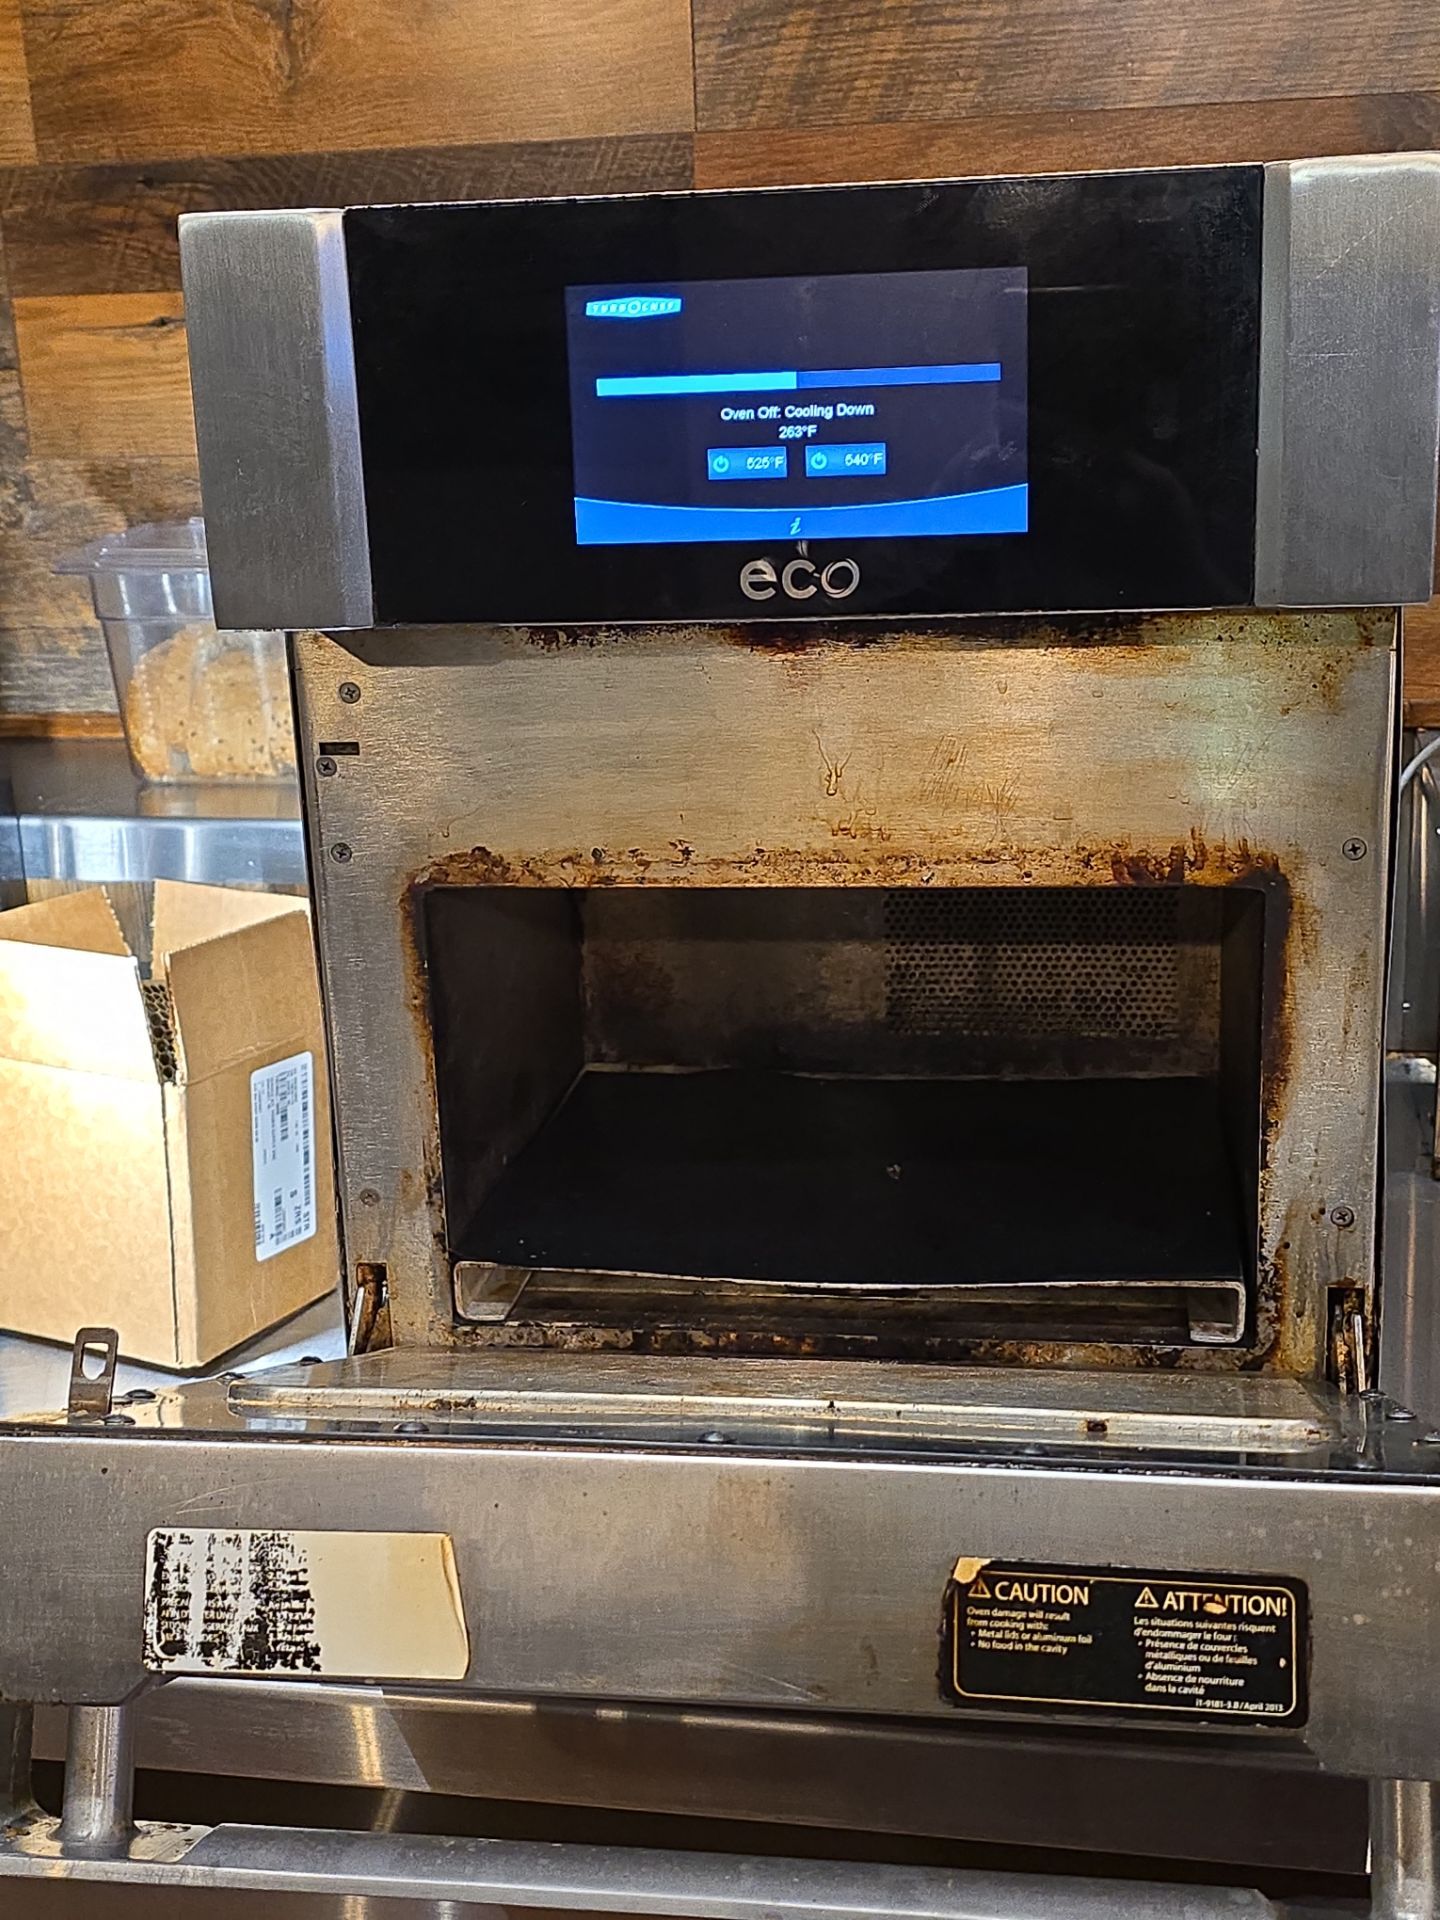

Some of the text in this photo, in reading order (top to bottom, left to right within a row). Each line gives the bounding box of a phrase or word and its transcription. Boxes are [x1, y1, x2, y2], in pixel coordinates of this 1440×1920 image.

[720, 403, 875, 420] Oven Off: Cooling Down
[740, 558, 860, 601] eco
[994, 1581, 1089, 1606] CAUTION
[967, 1606, 1070, 1620] Oven damage will result
[967, 1617, 1049, 1631] from cooking with:
[1134, 1616, 1276, 1634] Les situations suivantes risquent
[978, 1629, 1003, 1639] Metal
[1005, 1630, 1019, 1640] lids
[1032, 1632, 1076, 1643] aluminum
[1078, 1634, 1093, 1644] foil
[1134, 1628, 1201, 1641] d'endommager
[1203, 1631, 1211, 1640] le
[1213, 1631, 1231, 1641] four
[978, 1640, 1068, 1655] No food in the cavity
[1145, 1638, 1248, 1653] Présence de couvercles
[1145, 1650, 1258, 1665] métalliques ou de feuilles
[1145, 1661, 1201, 1672] d'aluminium
[1145, 1672, 1245, 1687] Absence de nourriture
[1145, 1683, 1205, 1695] dans la cavité
[1265, 1703, 1284, 1712] 2013
